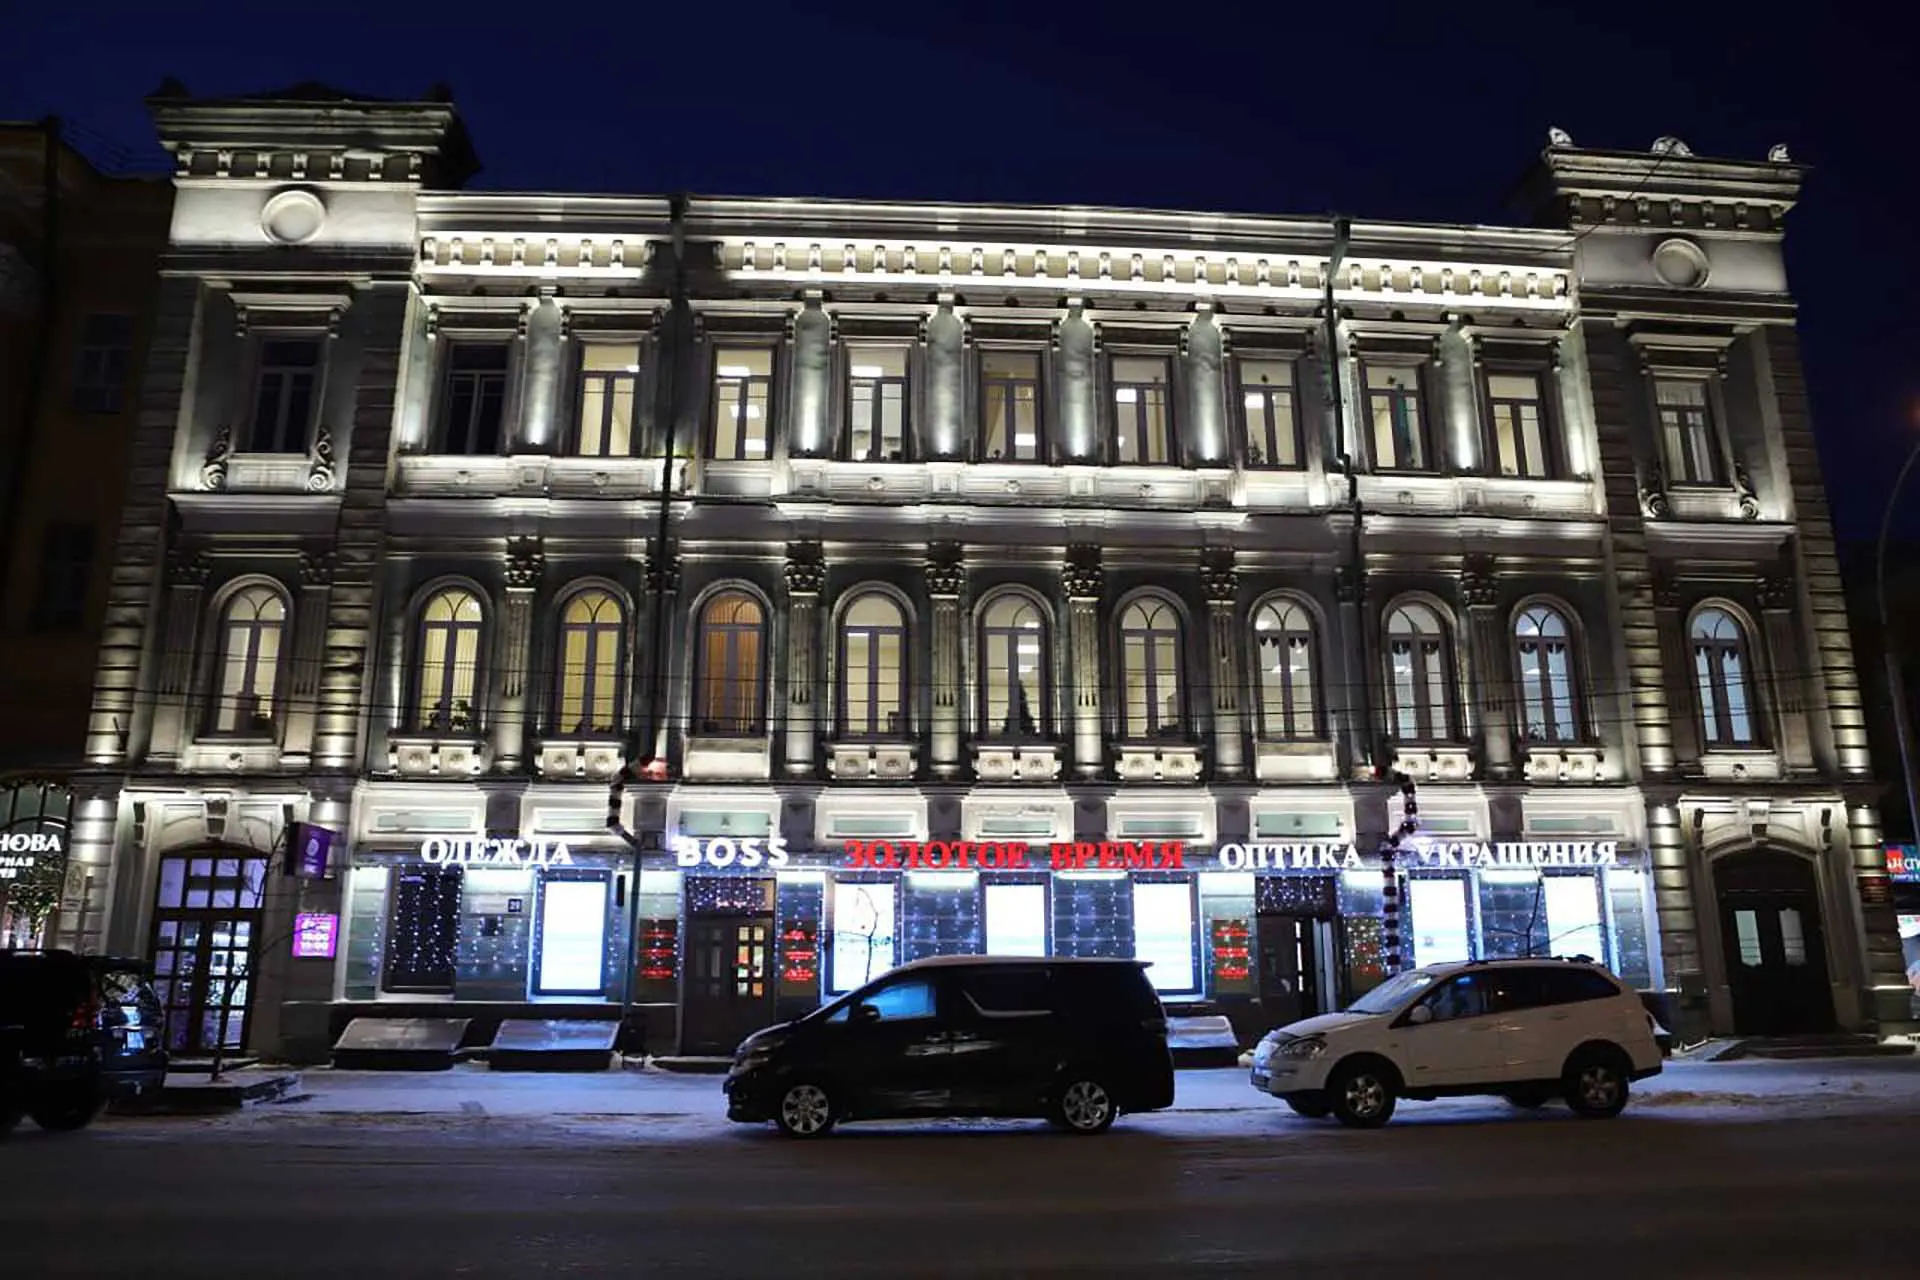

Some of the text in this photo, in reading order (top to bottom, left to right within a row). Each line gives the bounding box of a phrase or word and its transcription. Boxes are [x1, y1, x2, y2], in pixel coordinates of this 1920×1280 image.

[421, 838, 574, 870] ОДЕЖДА
[676, 837, 789, 867] BOSS
[844, 840, 1184, 869] ЗОЛОТОЕ ВРЕМЯ
[1219, 843, 1364, 869] ОПТИКА
[1411, 840, 1618, 866] УКРАШЕНИЯ
